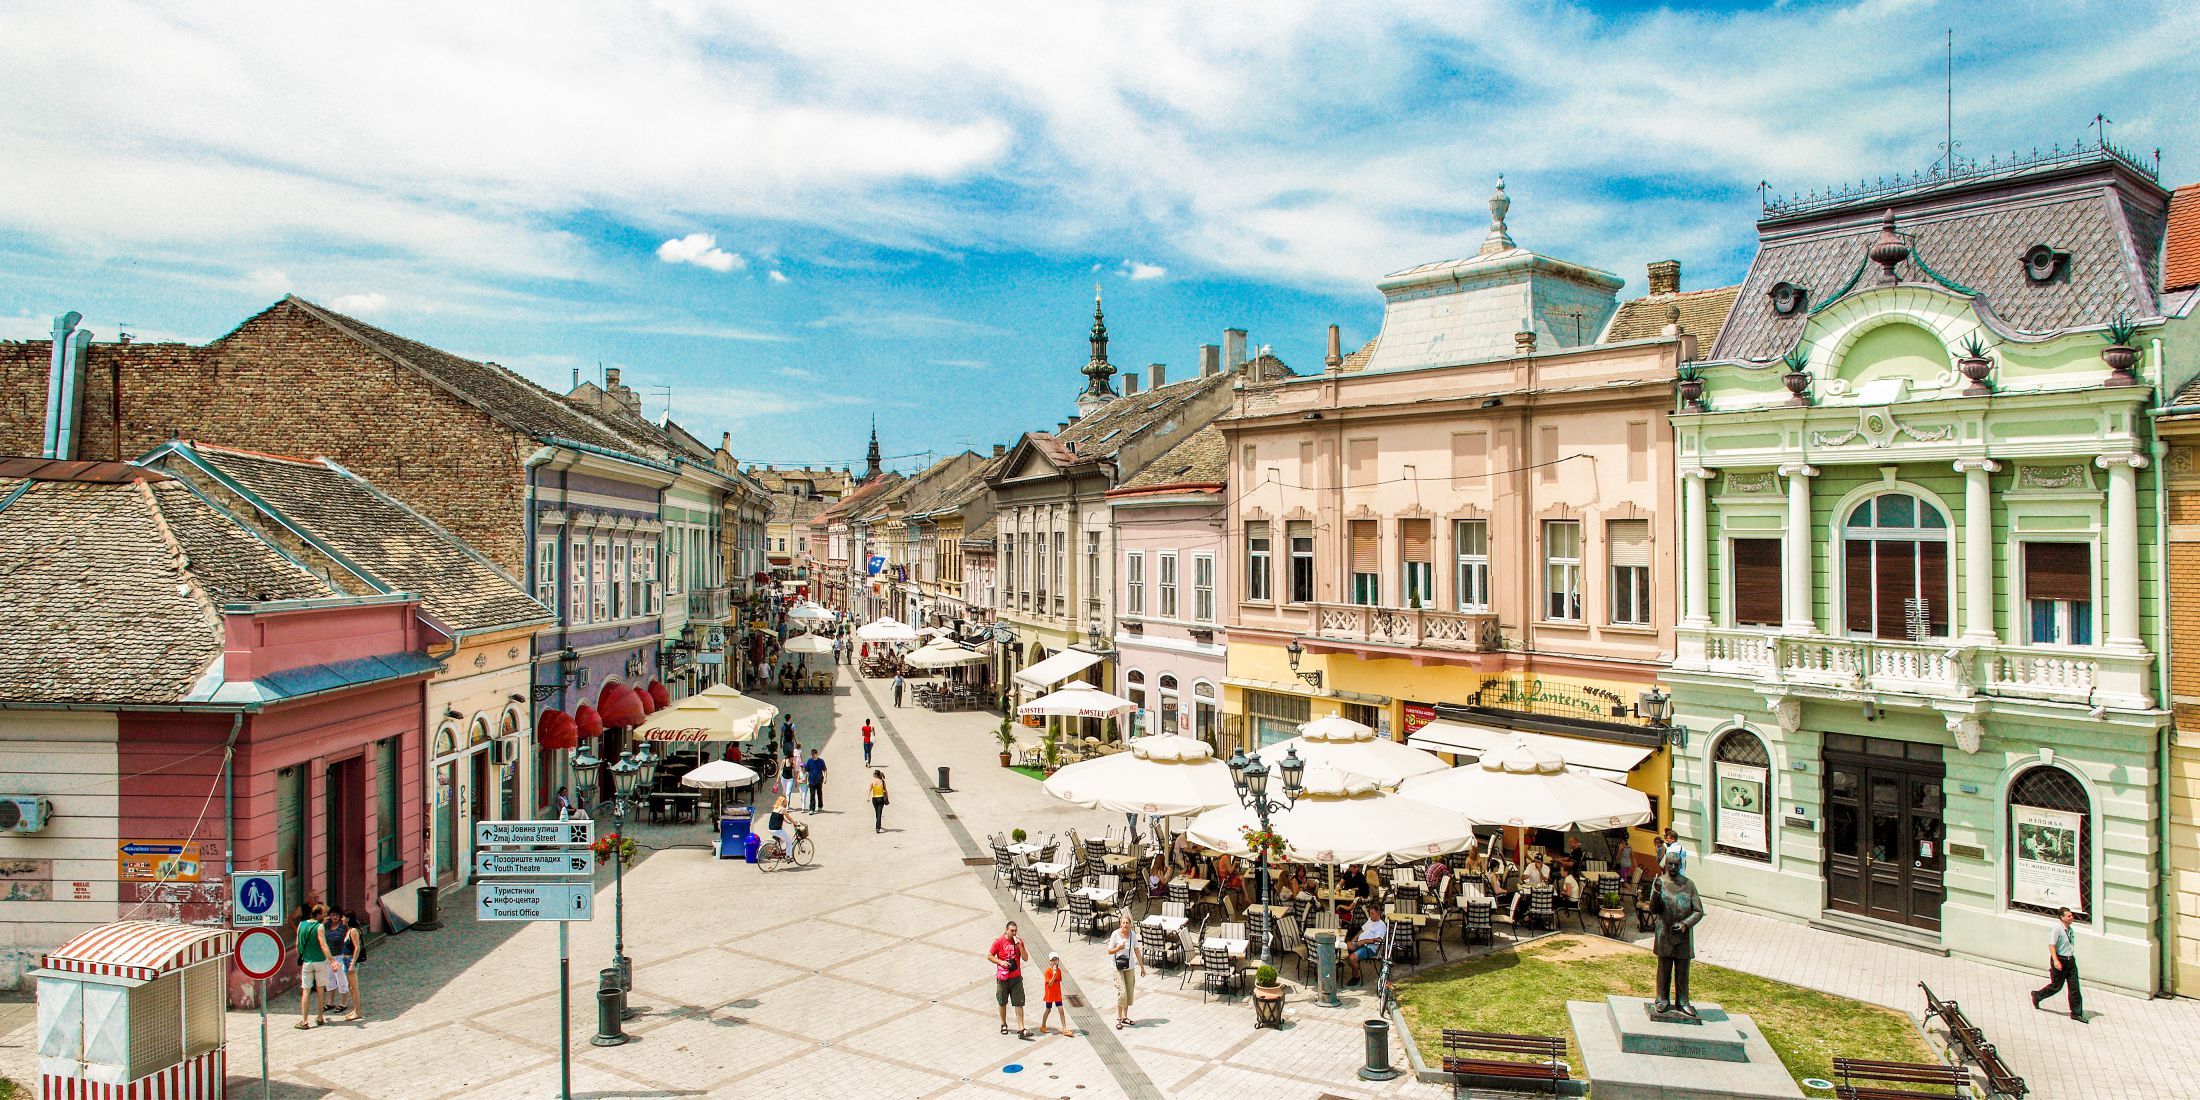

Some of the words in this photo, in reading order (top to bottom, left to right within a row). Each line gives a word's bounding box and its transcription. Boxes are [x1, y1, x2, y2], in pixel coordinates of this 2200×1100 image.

[1078, 708, 1106, 718] AMSTEL
[2028, 818, 2062, 826] ИЗЛОЖБА
[493, 825, 510, 834] Змај
[537, 826, 558, 834] улица
[494, 834, 510, 843] Zmaj
[494, 856, 533, 864] Позориште
[494, 887, 535, 896] Туристички
[494, 896, 540, 905] инфо-центар
